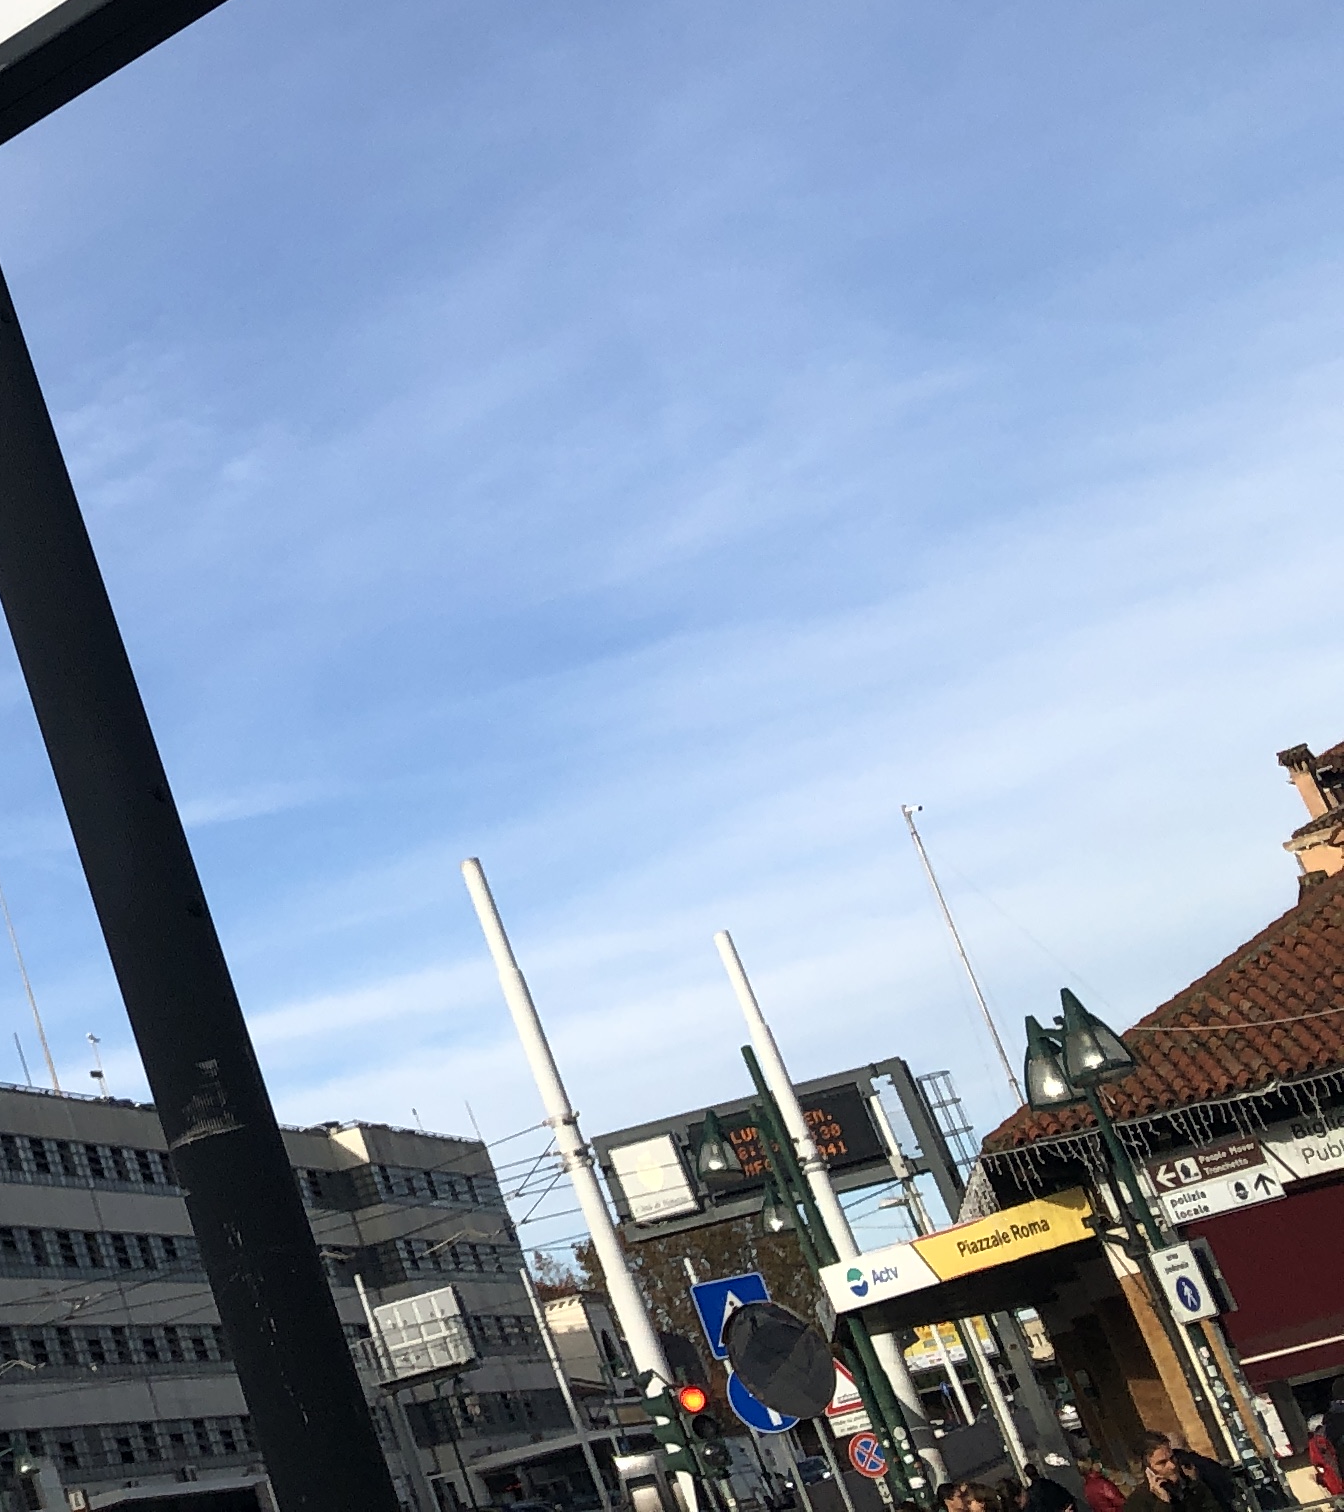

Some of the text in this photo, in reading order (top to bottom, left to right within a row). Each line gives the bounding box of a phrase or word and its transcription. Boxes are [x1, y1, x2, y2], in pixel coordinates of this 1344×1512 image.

[1198, 1142, 1255, 1165] People Mover
[1170, 1189, 1207, 1208] polizia
[1175, 1204, 1210, 1220] locale
[957, 1217, 1051, 1257] Piazzale Roma
[872, 1265, 899, 1286] Actv
